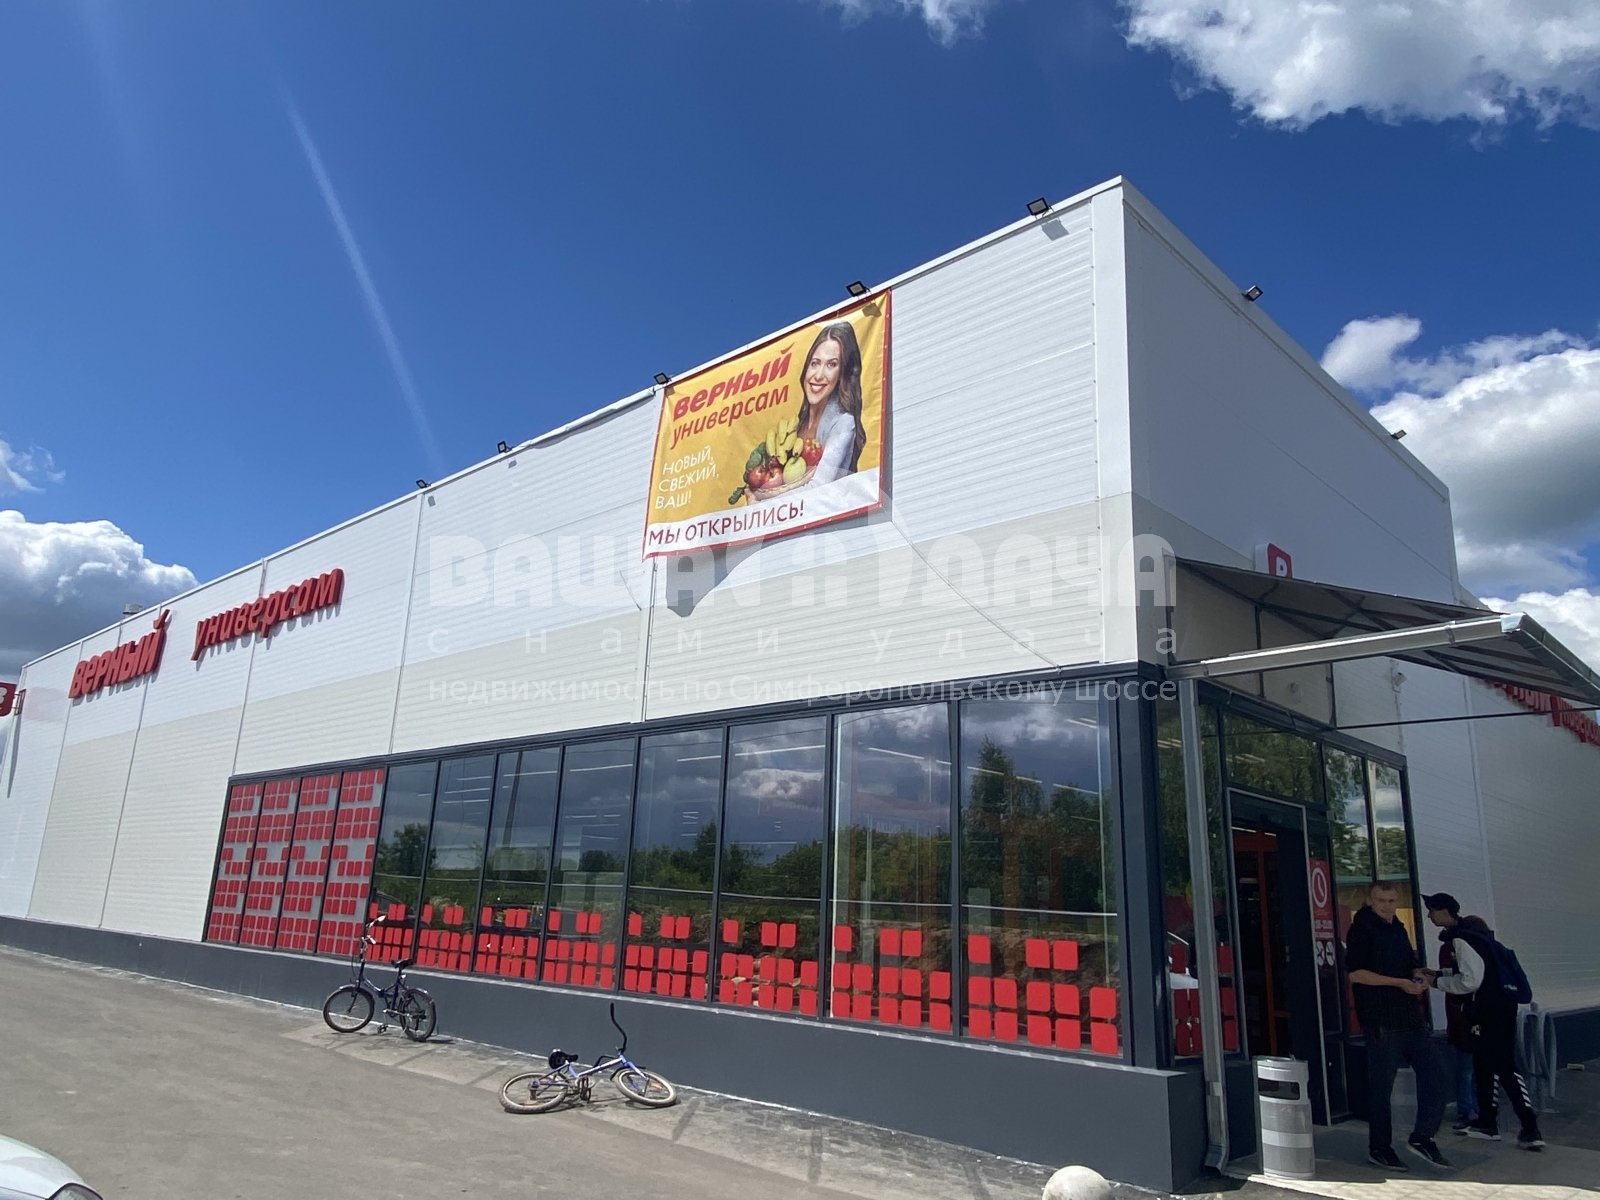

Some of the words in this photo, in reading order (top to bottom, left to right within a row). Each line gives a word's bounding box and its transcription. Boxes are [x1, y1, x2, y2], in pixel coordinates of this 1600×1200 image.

[670, 385, 789, 450] универсам
[658, 462, 720, 492] СВЕЖИЙ,
[663, 445, 714, 475] НОВЫЙ,
[655, 490, 692, 510] ВАШ!
[649, 527, 680, 546] МЫ
[685, 499, 804, 541] ОТКРЫЛИСЬ!
[190, 568, 345, 661] универсам
